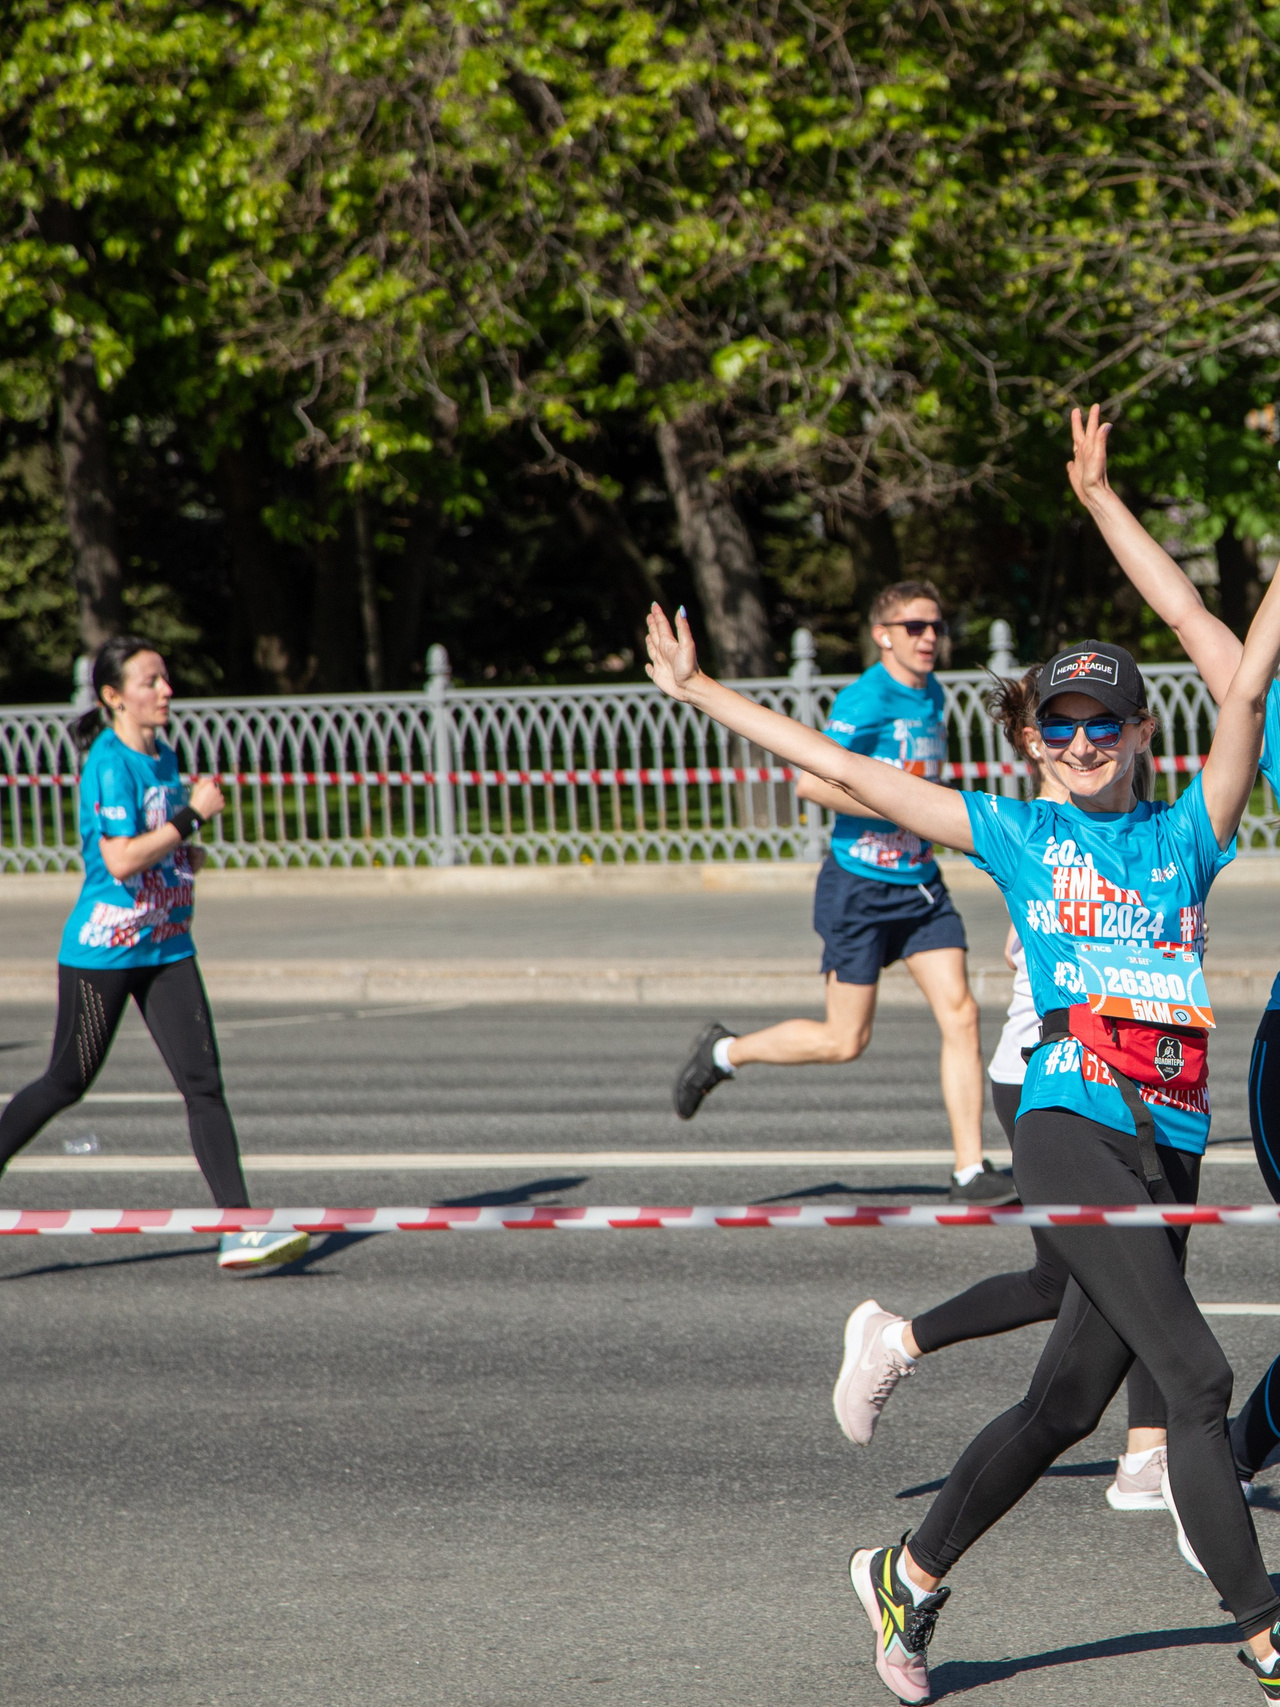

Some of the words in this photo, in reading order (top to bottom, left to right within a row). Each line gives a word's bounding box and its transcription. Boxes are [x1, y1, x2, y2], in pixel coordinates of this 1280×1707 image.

[1057, 662, 1079, 675] HERO
[1080, 662, 1113, 675] LEAGUE
[1026, 899, 1165, 940] #ЗАБЕГ2024
[1092, 944, 1113, 953] ПСБ
[1103, 966, 1188, 1002] 26380
[1129, 998, 1174, 1025] 5KM
[1175, 1011, 1189, 1023] D
